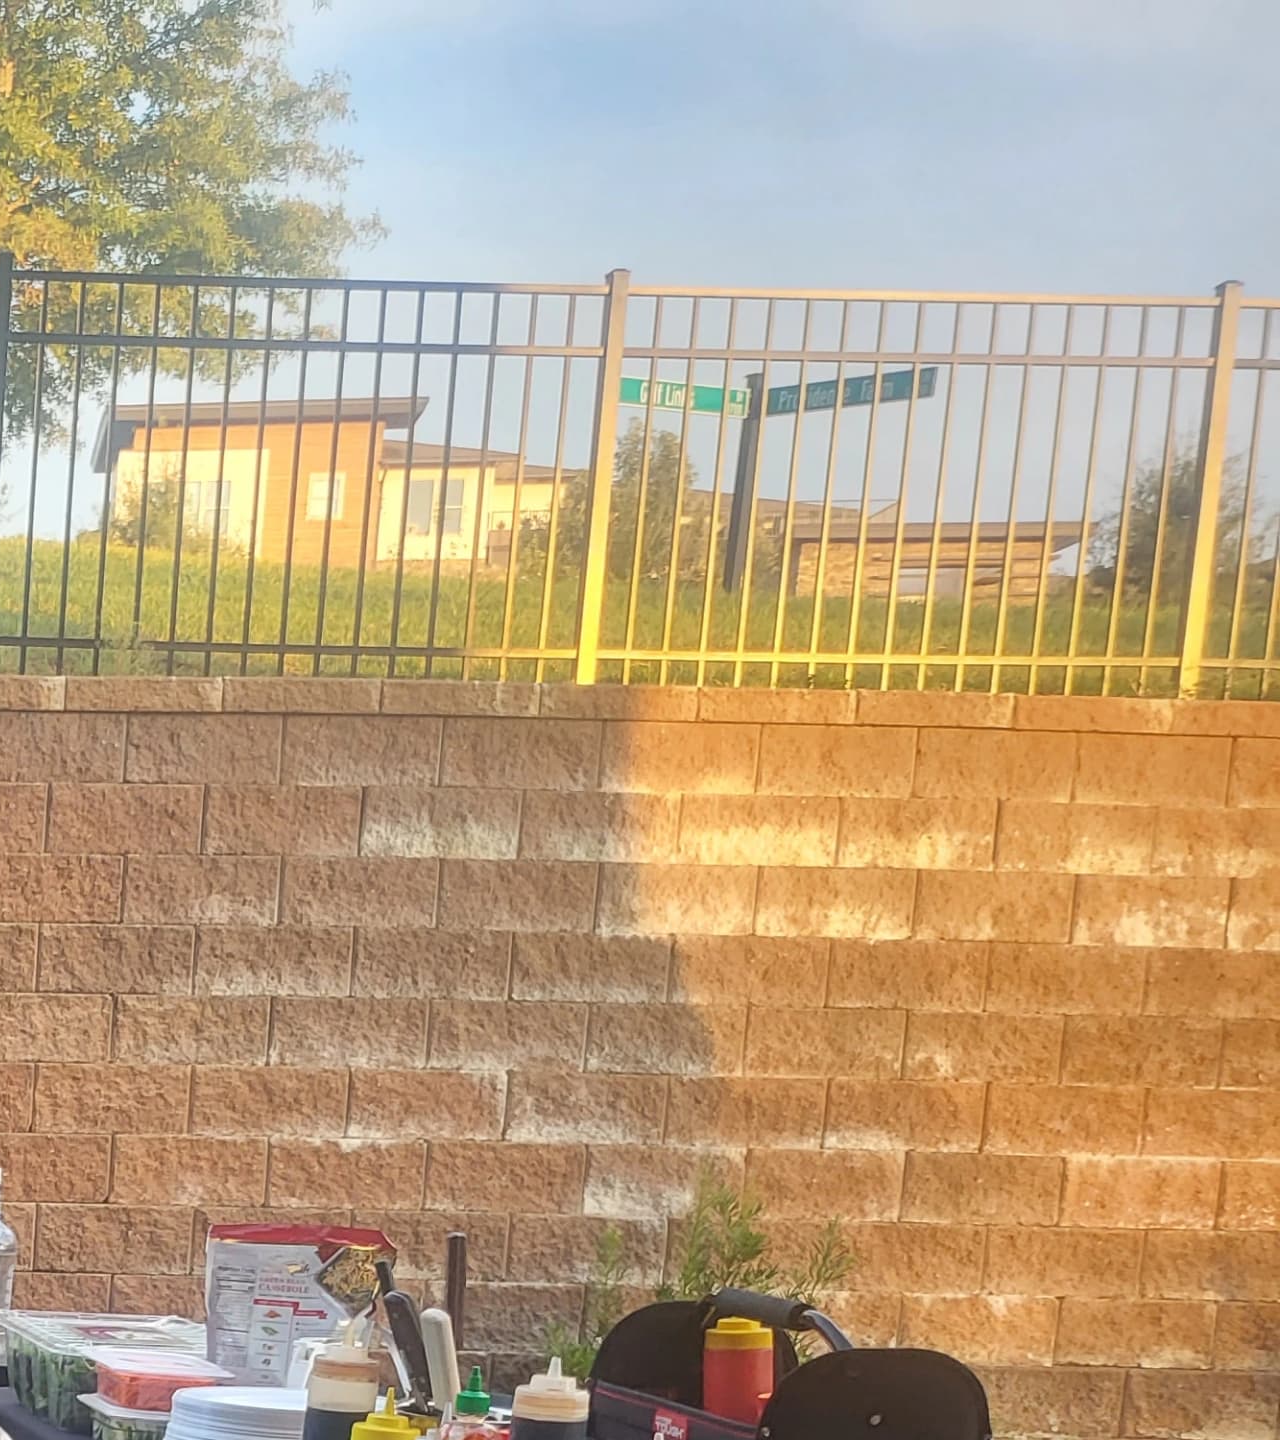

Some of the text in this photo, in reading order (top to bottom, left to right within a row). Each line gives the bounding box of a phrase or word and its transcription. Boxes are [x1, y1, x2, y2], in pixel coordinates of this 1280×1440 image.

[640, 382, 664, 405] Glf
[777, 384, 851, 411] Proidene
[859, 379, 895, 401] Fam
